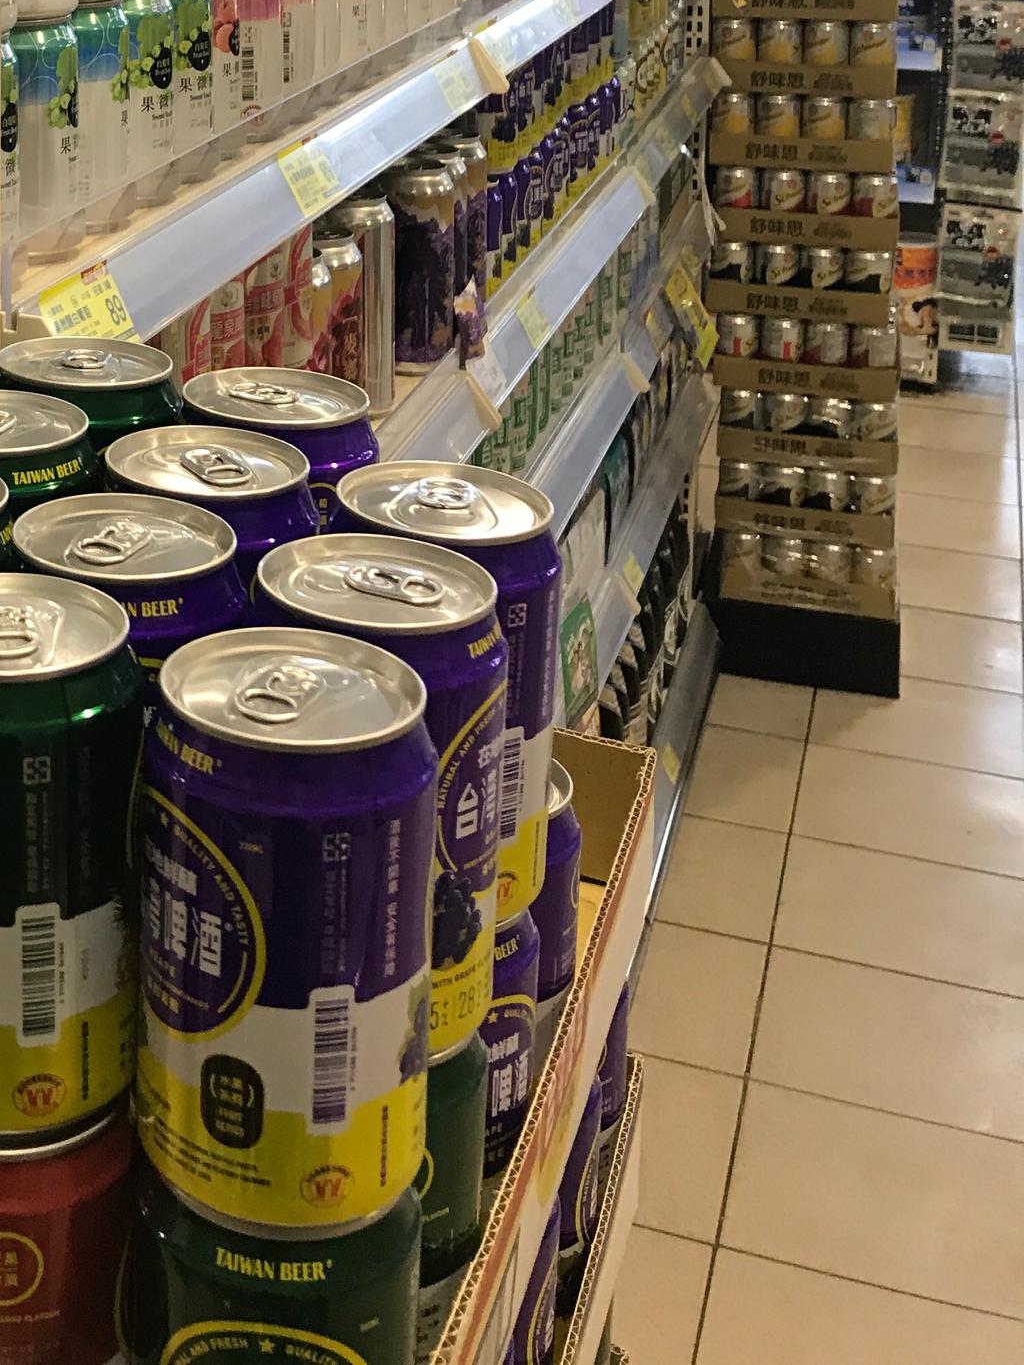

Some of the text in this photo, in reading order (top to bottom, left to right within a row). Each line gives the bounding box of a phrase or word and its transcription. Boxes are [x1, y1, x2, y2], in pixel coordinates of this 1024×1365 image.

[105, 294, 127, 326] 89
[12, 466, 56, 486] TAIWAN
[141, 600, 179, 619] BEER
[181, 744, 214, 775] BEER
[438, 760, 461, 810] NATURAL
[494, 937, 519, 962] BEER
[215, 1246, 326, 1282] TAIWAN BEER
